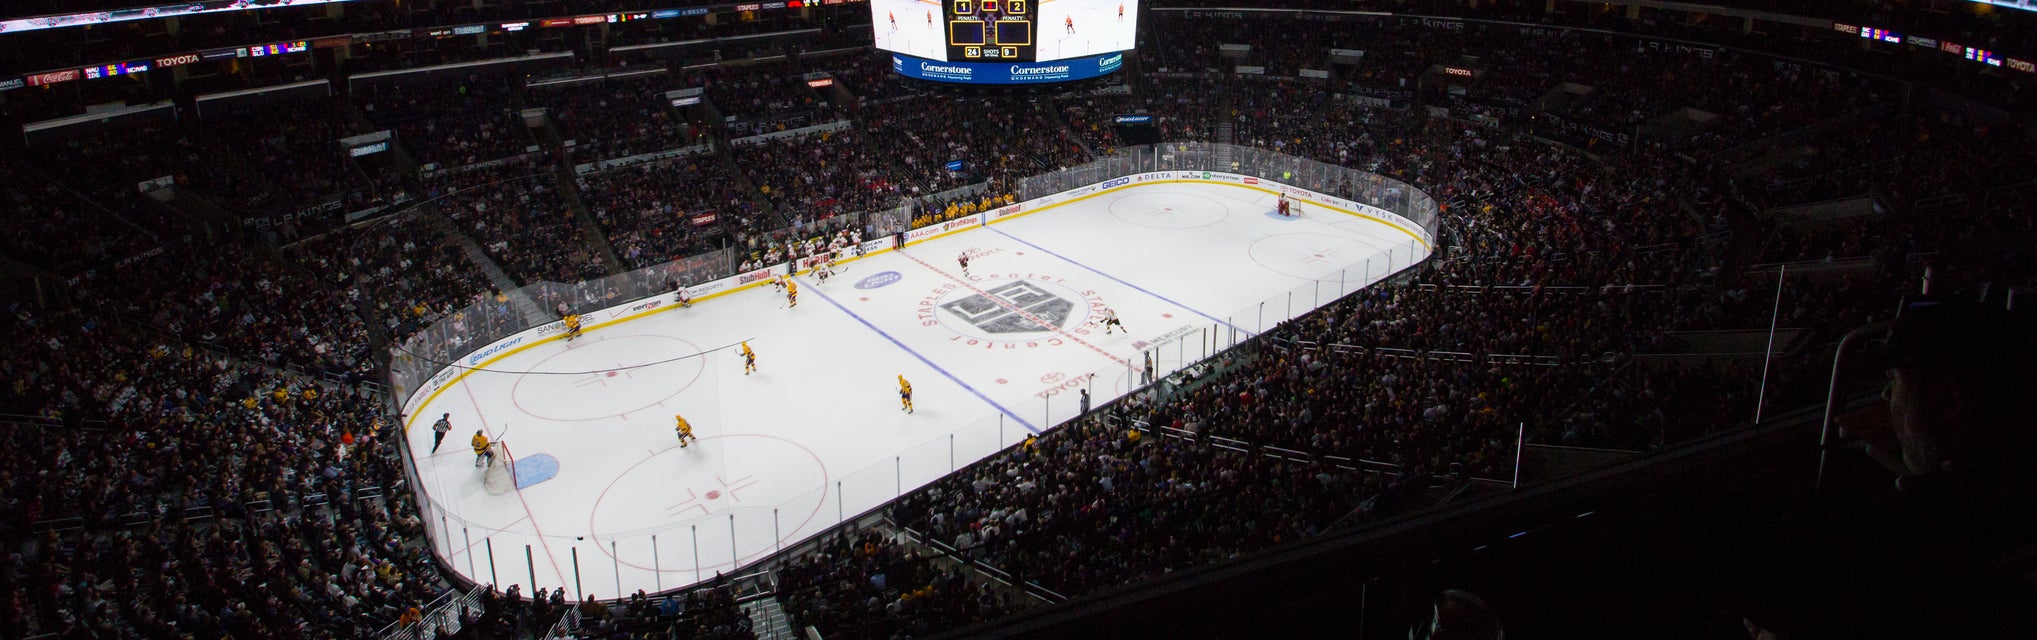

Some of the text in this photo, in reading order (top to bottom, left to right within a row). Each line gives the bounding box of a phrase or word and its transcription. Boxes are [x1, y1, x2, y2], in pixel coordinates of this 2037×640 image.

[961, 2, 967, 11] 1
[1014, 2, 1021, 11] 2
[155, 54, 200, 68] TOYOTA
[921, 61, 972, 75] Cornerstone
[2006, 58, 2036, 73] TOYOTA
[1010, 64, 1069, 75] Cornerstone
[1445, 67, 1472, 77] TOYOTA
[1102, 177, 1130, 190] GEICO
[1145, 172, 1171, 181] DELTA
[1288, 187, 1312, 199] TOYOTA
[949, 216, 978, 230] DraftKings
[910, 227, 939, 241] AAA.com
[739, 269, 771, 285] StubHub!
[632, 299, 662, 313] verizon
[918, 273, 1070, 327] STAPLES Center
[471, 337, 523, 365] BUD LIGHT
[1034, 373, 1098, 399] TOYOTA
